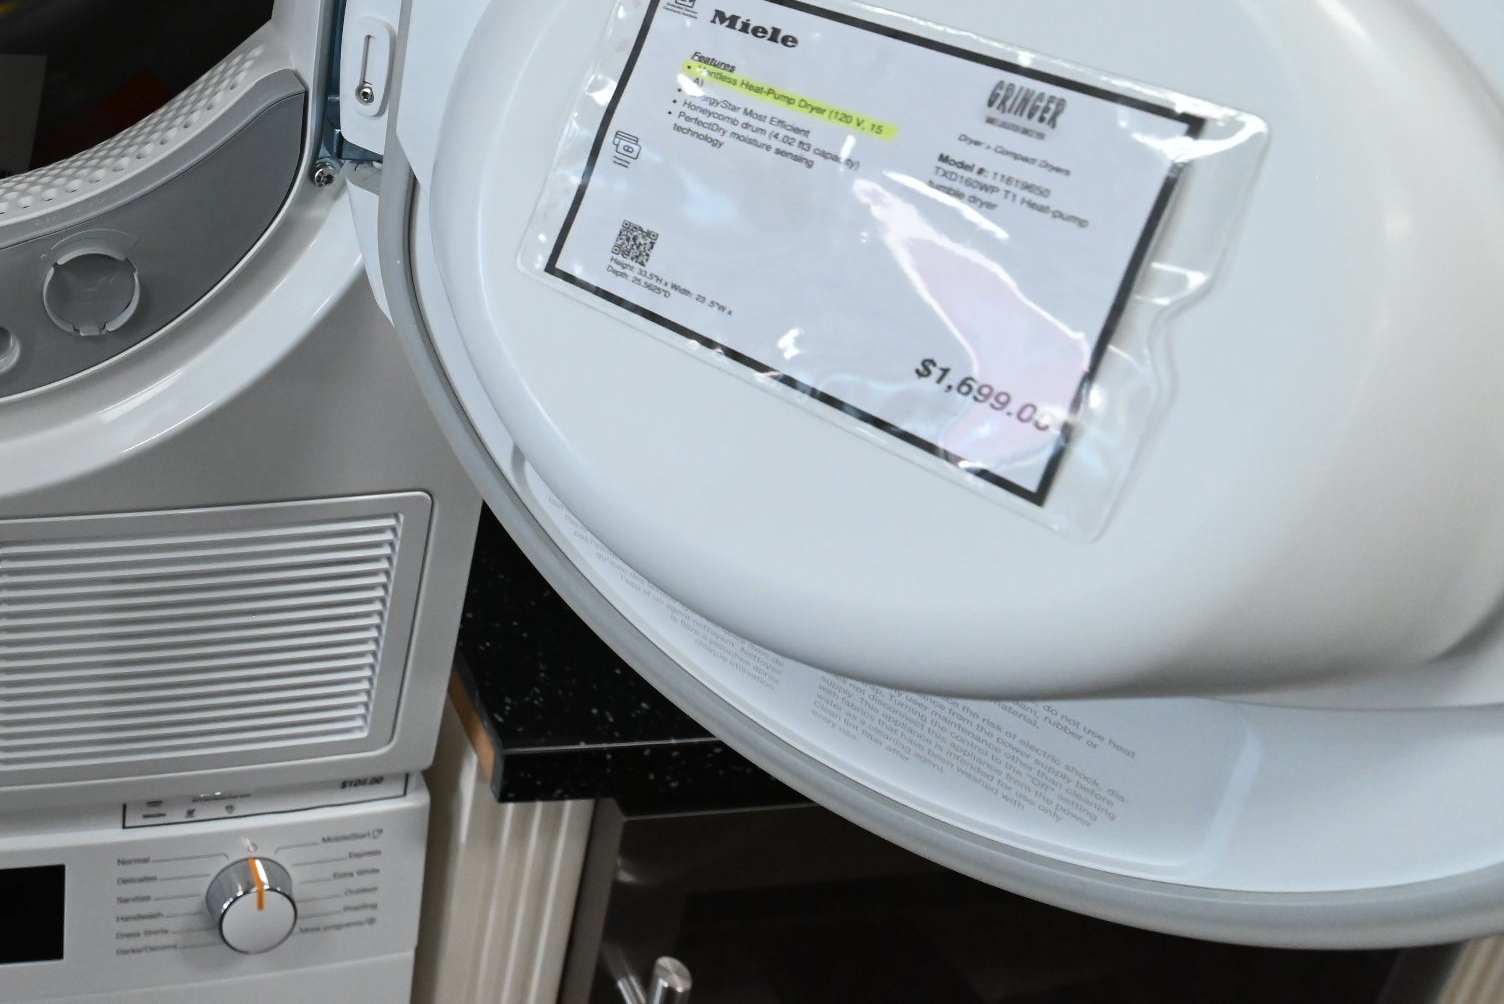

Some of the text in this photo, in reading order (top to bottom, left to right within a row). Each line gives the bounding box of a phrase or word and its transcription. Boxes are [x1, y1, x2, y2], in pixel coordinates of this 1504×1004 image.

[710, 9, 798, 48] Miele
[691, 50, 736, 73] Features
[738, 79, 797, 107] Heat-Pump
[796, 99, 826, 117] Dryer
[827, 108, 854, 125] (120
[869, 122, 884, 134] 15
[986, 79, 1067, 129] GRINGER
[671, 122, 725, 149] technology
[681, 99, 740, 127] Honeycomb
[740, 120, 767, 136] drum
[767, 129, 796, 147] (4.02
[741, 107, 811, 137] Most Efficient
[676, 111, 815, 169] PerfectDry moisture sensing
[937, 153, 975, 174] Model
[967, 192, 998, 211] dryer
[1003, 188, 1017, 202] T1
[1019, 197, 1090, 228] Heat-pump
[605, 263, 631, 281] Depth:
[608, 254, 635, 273] Height:
[930, 718, 946, 732] the
[948, 708, 973, 727] from
[976, 724, 993, 738] the
[961, 704, 979, 719] the
[982, 716, 1002, 732] risk
[1060, 714, 1080, 729] not
[1034, 789, 1052, 805] the
